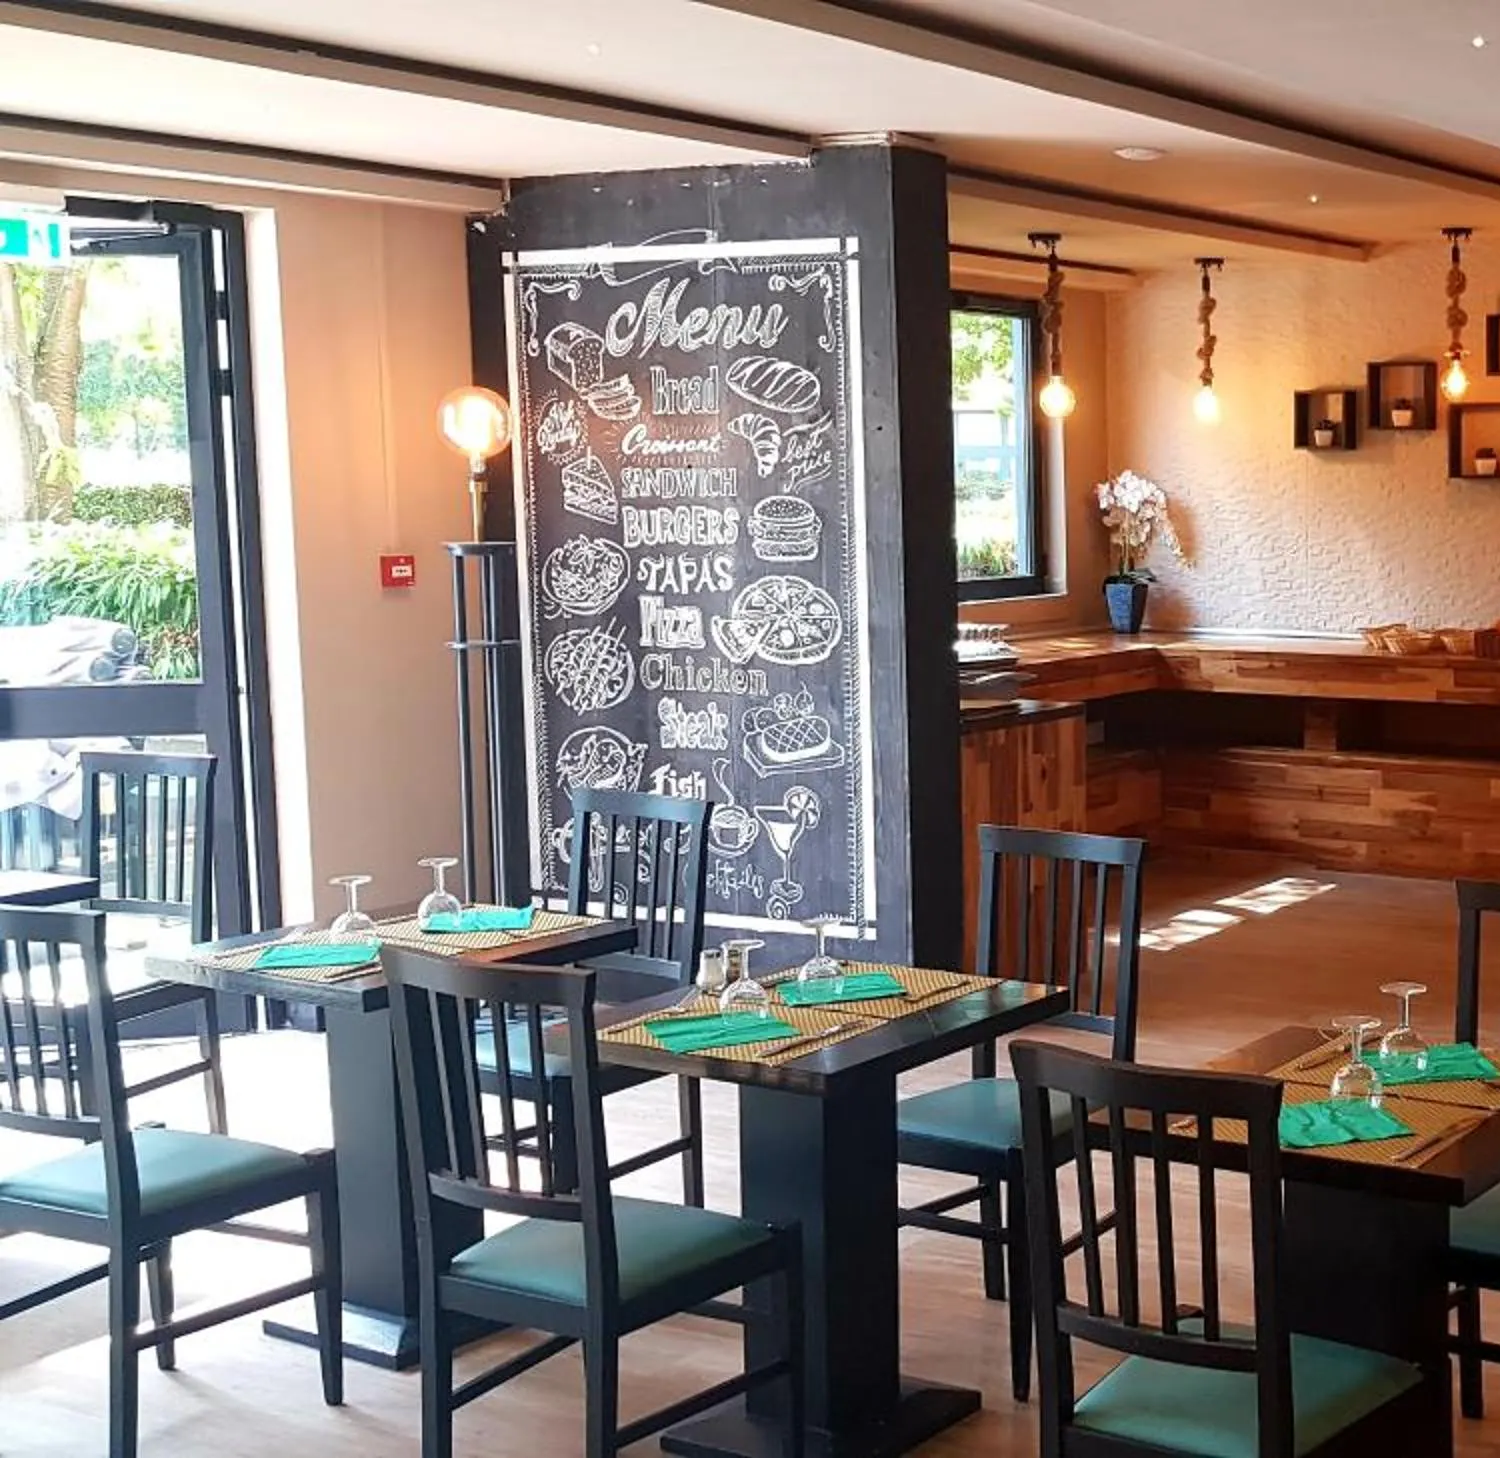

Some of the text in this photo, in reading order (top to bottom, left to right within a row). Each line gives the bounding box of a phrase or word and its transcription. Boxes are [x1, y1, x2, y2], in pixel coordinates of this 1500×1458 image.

[606, 277, 789, 360] Menu
[650, 365, 720, 415] Bread
[621, 466, 737, 498] SANDWICH
[622, 506, 740, 548] BURGERS
[637, 551, 734, 595] TAPAS
[638, 594, 706, 649] Pizza
[640, 653, 769, 697] Chicken
[658, 697, 729, 750] Steak
[648, 763, 707, 800] Fish
